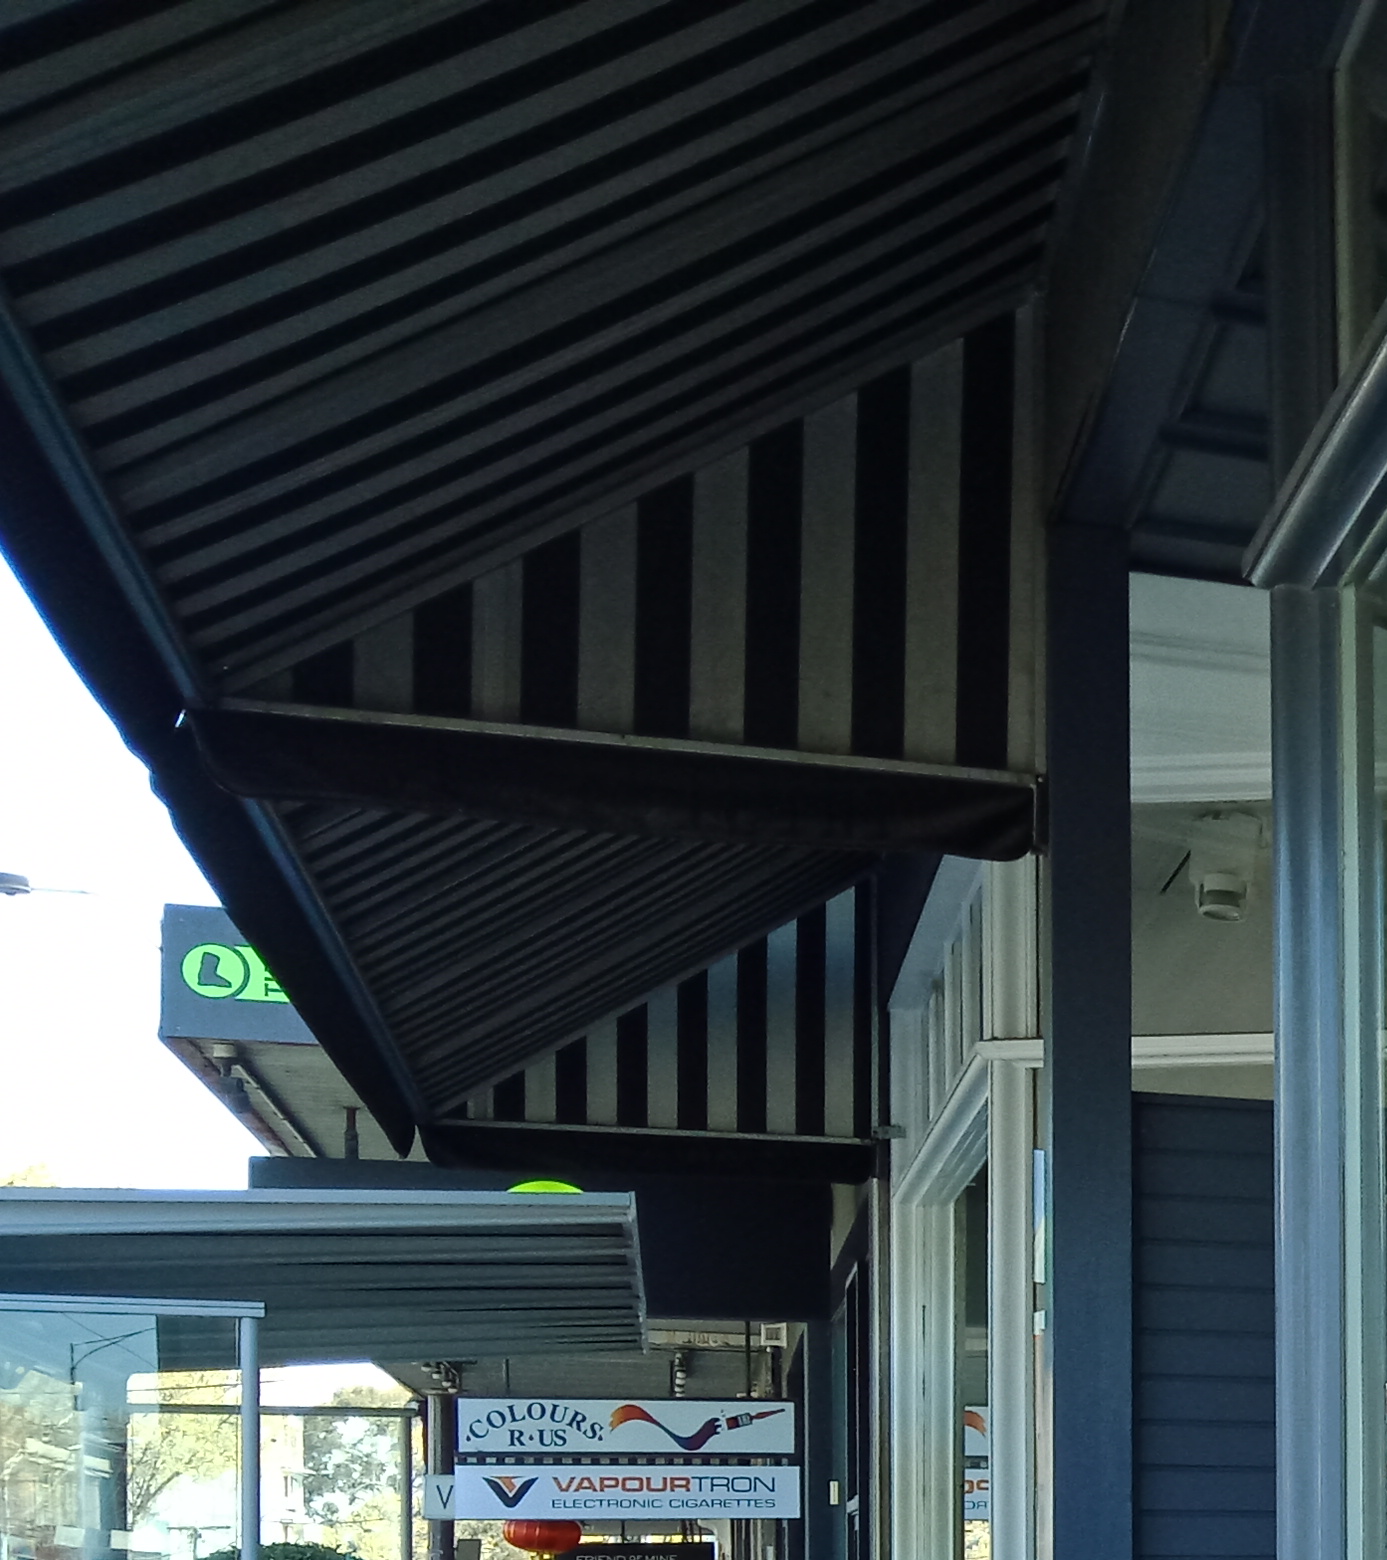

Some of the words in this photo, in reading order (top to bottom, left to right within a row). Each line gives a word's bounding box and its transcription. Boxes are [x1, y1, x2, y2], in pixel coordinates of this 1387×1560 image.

[469, 1401, 602, 1441] COLOURS
[551, 1476, 777, 1493] VAPOURTRON
[551, 1498, 663, 1509] ELECTRONIC
[668, 1498, 777, 1509] CIGARETTES
